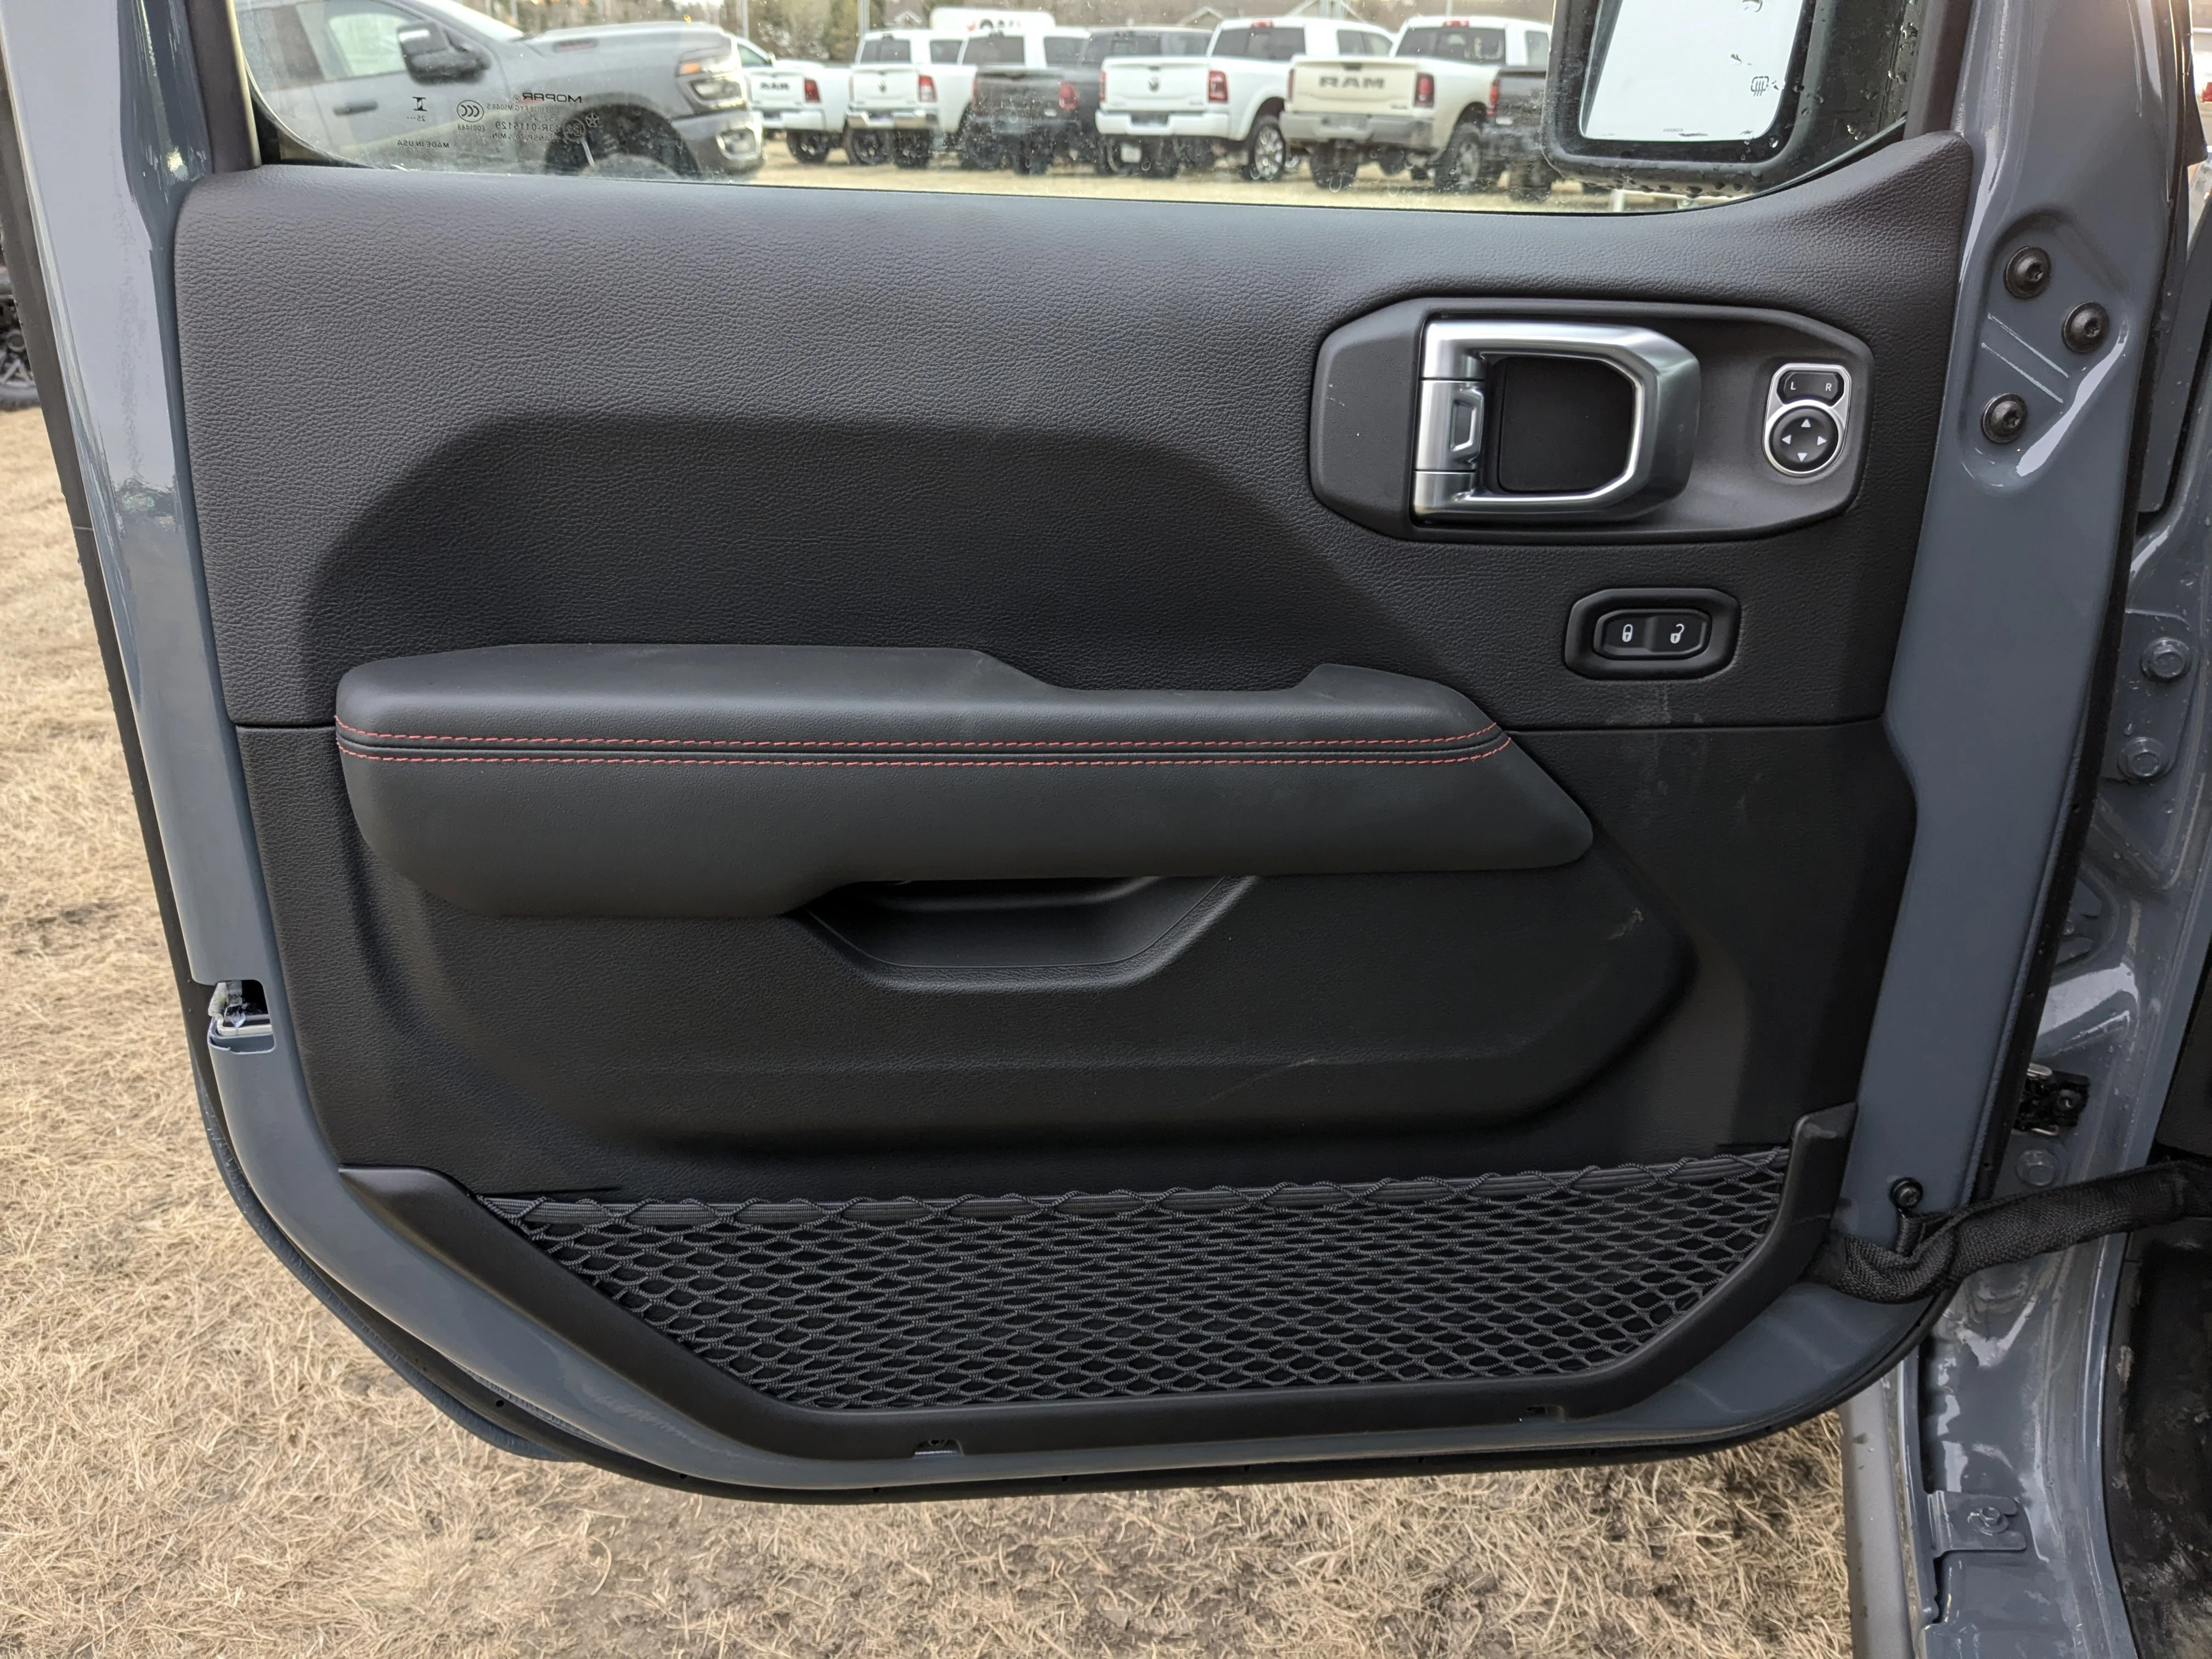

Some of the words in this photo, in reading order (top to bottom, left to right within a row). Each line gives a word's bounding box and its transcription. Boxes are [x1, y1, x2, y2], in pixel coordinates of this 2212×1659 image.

[1319, 76, 1385, 89] RAM
[1790, 381, 1796, 390] L
[1825, 383, 1832, 391] R
